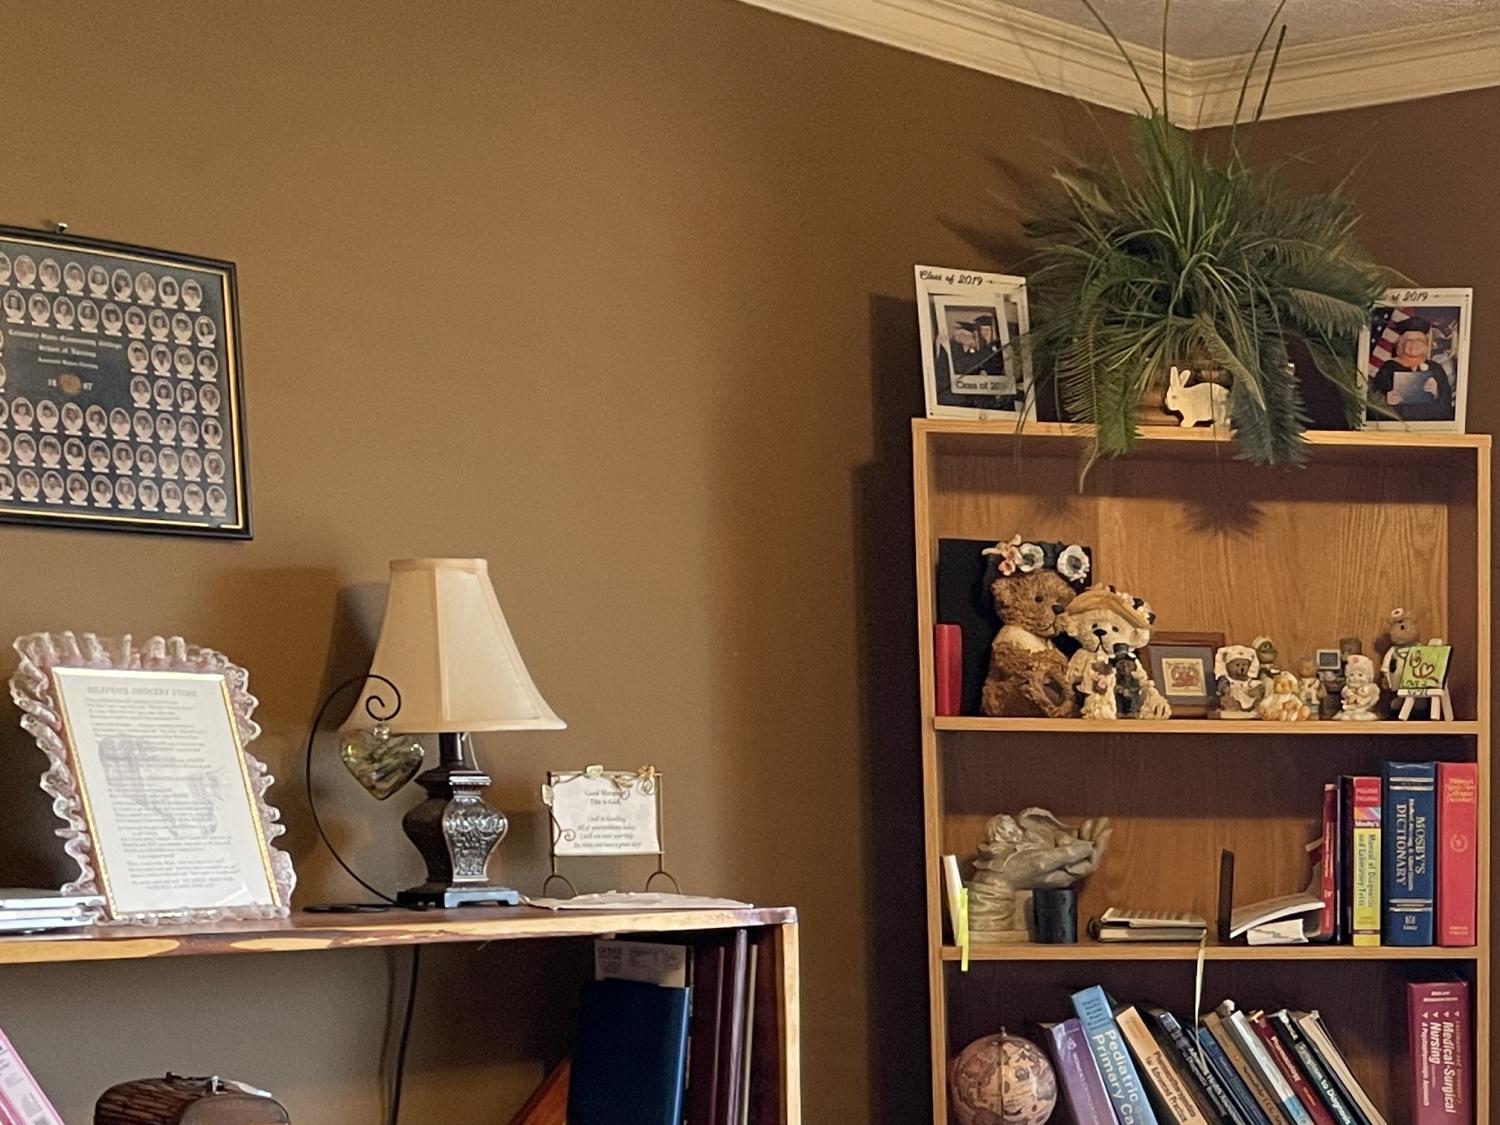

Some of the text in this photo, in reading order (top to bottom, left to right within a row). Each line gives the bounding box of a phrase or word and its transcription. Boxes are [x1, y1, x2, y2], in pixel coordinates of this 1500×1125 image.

[920, 270, 984, 287] Class of 2019
[1402, 291, 1429, 302] 2019
[1396, 804, 1407, 885] DICTIONARY
[1415, 816, 1426, 875] MOSBY'S
[1105, 1029, 1138, 1102] Pediatric
[1269, 1034, 1301, 1082] Pharmacology
[1297, 1042, 1324, 1081] Symptom
[1320, 1079, 1329, 1089] to
[1428, 1021, 1442, 1064] Nursing
[1092, 1034, 1125, 1100] Primary
[1150, 1066, 1173, 1096] Advanced
[1439, 1021, 1456, 1113] Medical-Surgical
